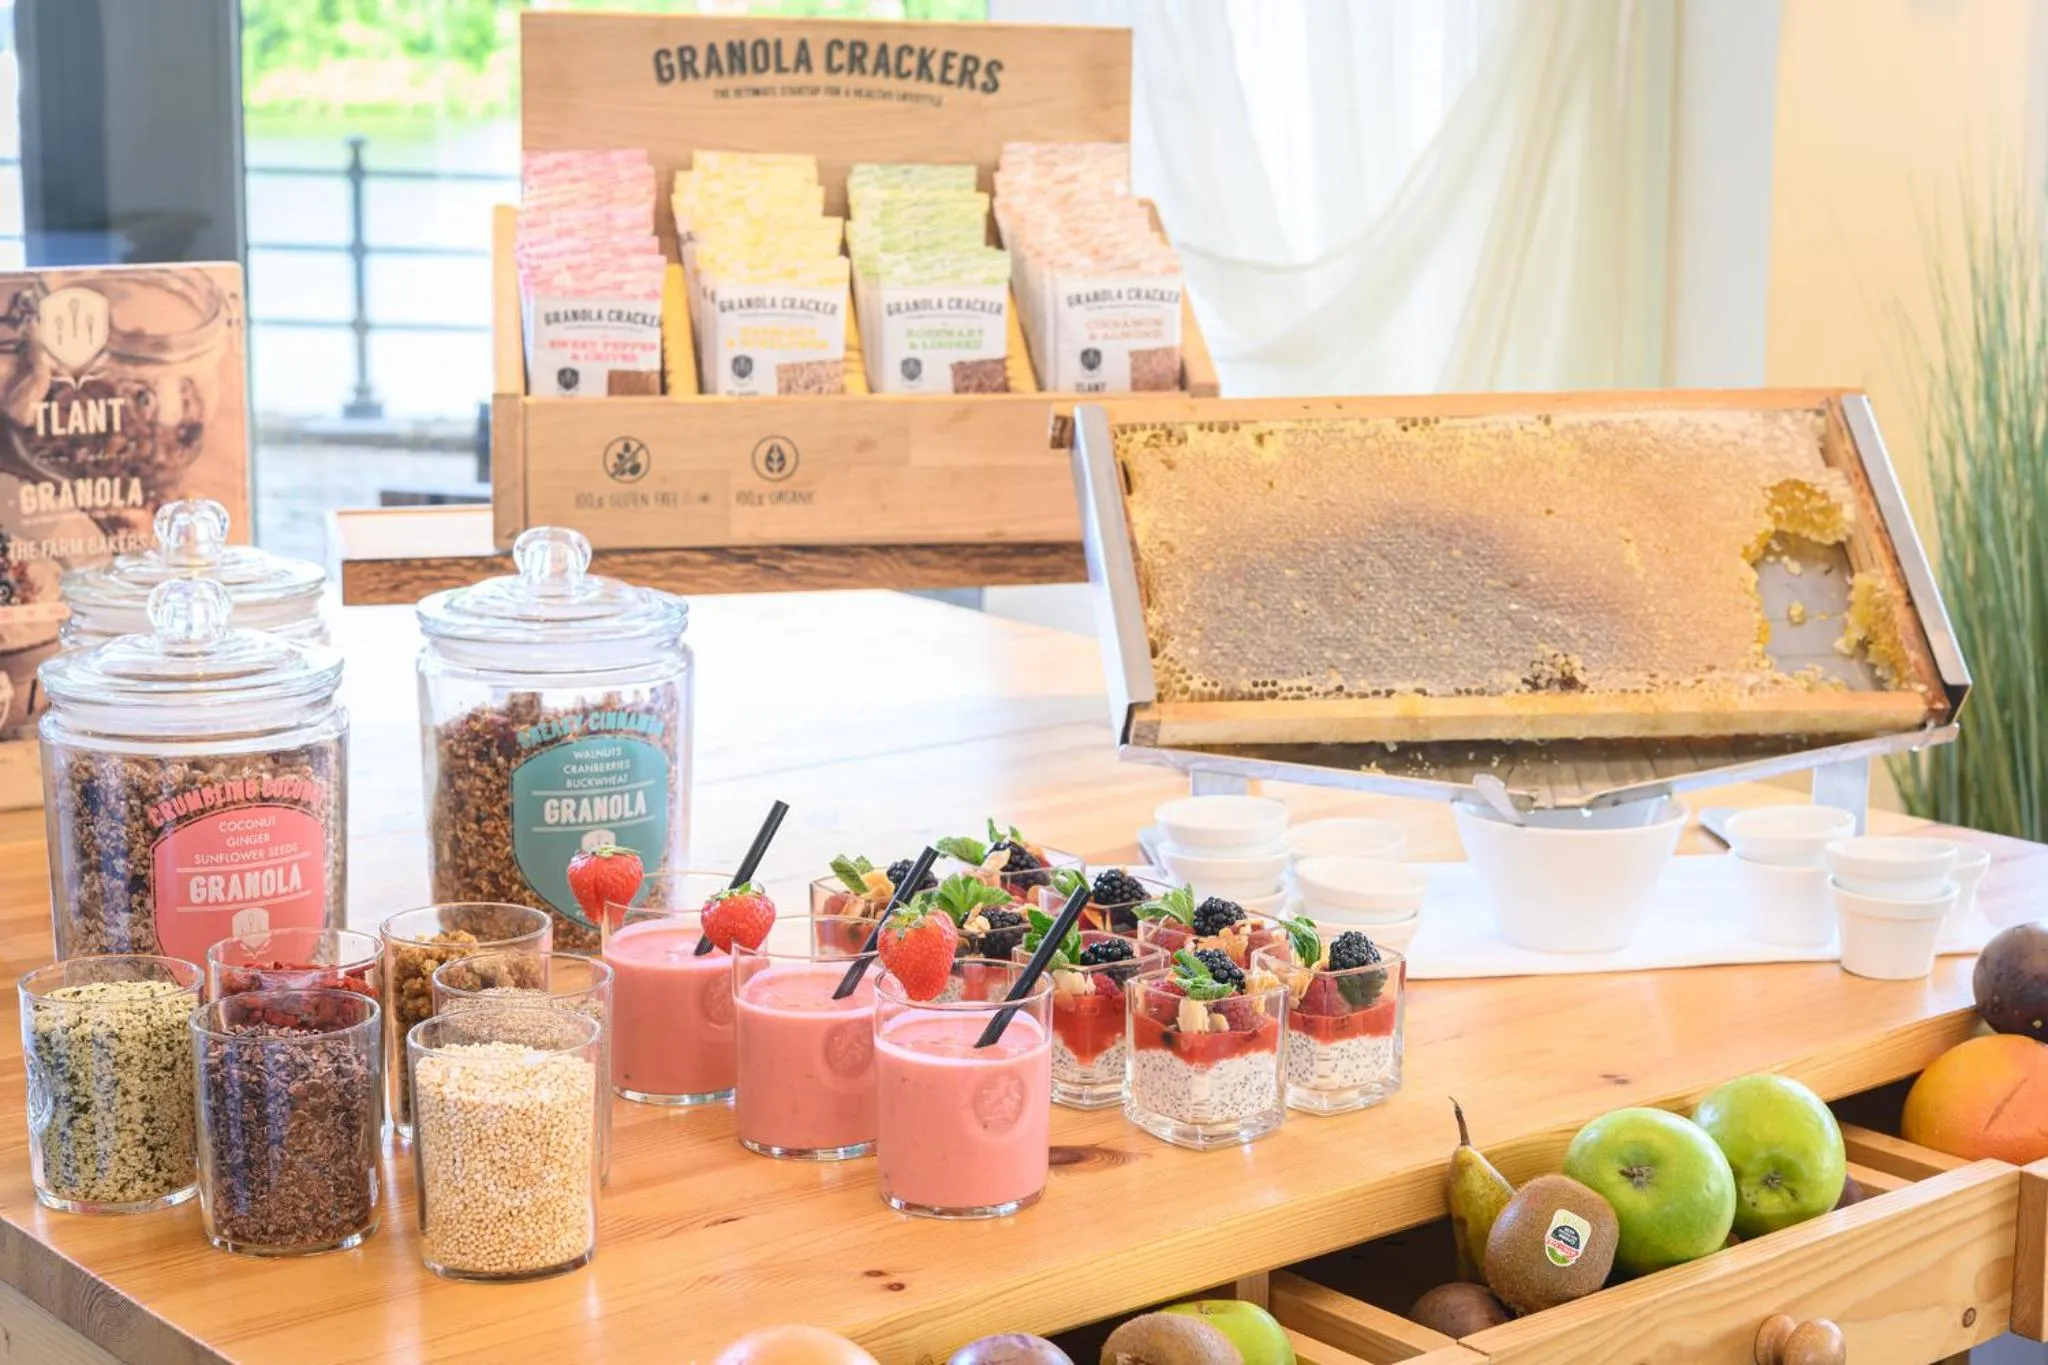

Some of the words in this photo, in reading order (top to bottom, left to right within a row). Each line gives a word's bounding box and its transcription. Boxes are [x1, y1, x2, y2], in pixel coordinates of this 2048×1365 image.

[653, 38, 812, 85] GRANOLA
[824, 39, 1004, 95] CRACKERS
[719, 296, 776, 313] GRANOLA
[781, 297, 838, 316] CRACKER
[886, 298, 943, 317] GRANOLA
[947, 298, 1003, 316] CRACKER
[1067, 289, 1122, 308] GRANOLA
[544, 309, 602, 327] GRANOLA
[34, 398, 125, 437] TLANT
[20, 477, 144, 514] GRANOLA
[8, 541, 38, 560] THE
[41, 539, 82, 557] FARM
[572, 746, 622, 759] WALNUTS
[563, 759, 631, 774] CRANBERRIES
[566, 774, 628, 789] BUCKWHEAT
[543, 790, 646, 825] GRANOLA
[218, 816, 276, 833] COCONUT
[226, 833, 270, 848] GINGER
[194, 850, 265, 865] SUNFLOWER
[268, 842, 299, 857] SEEDS
[189, 863, 302, 904] GRANOLA
